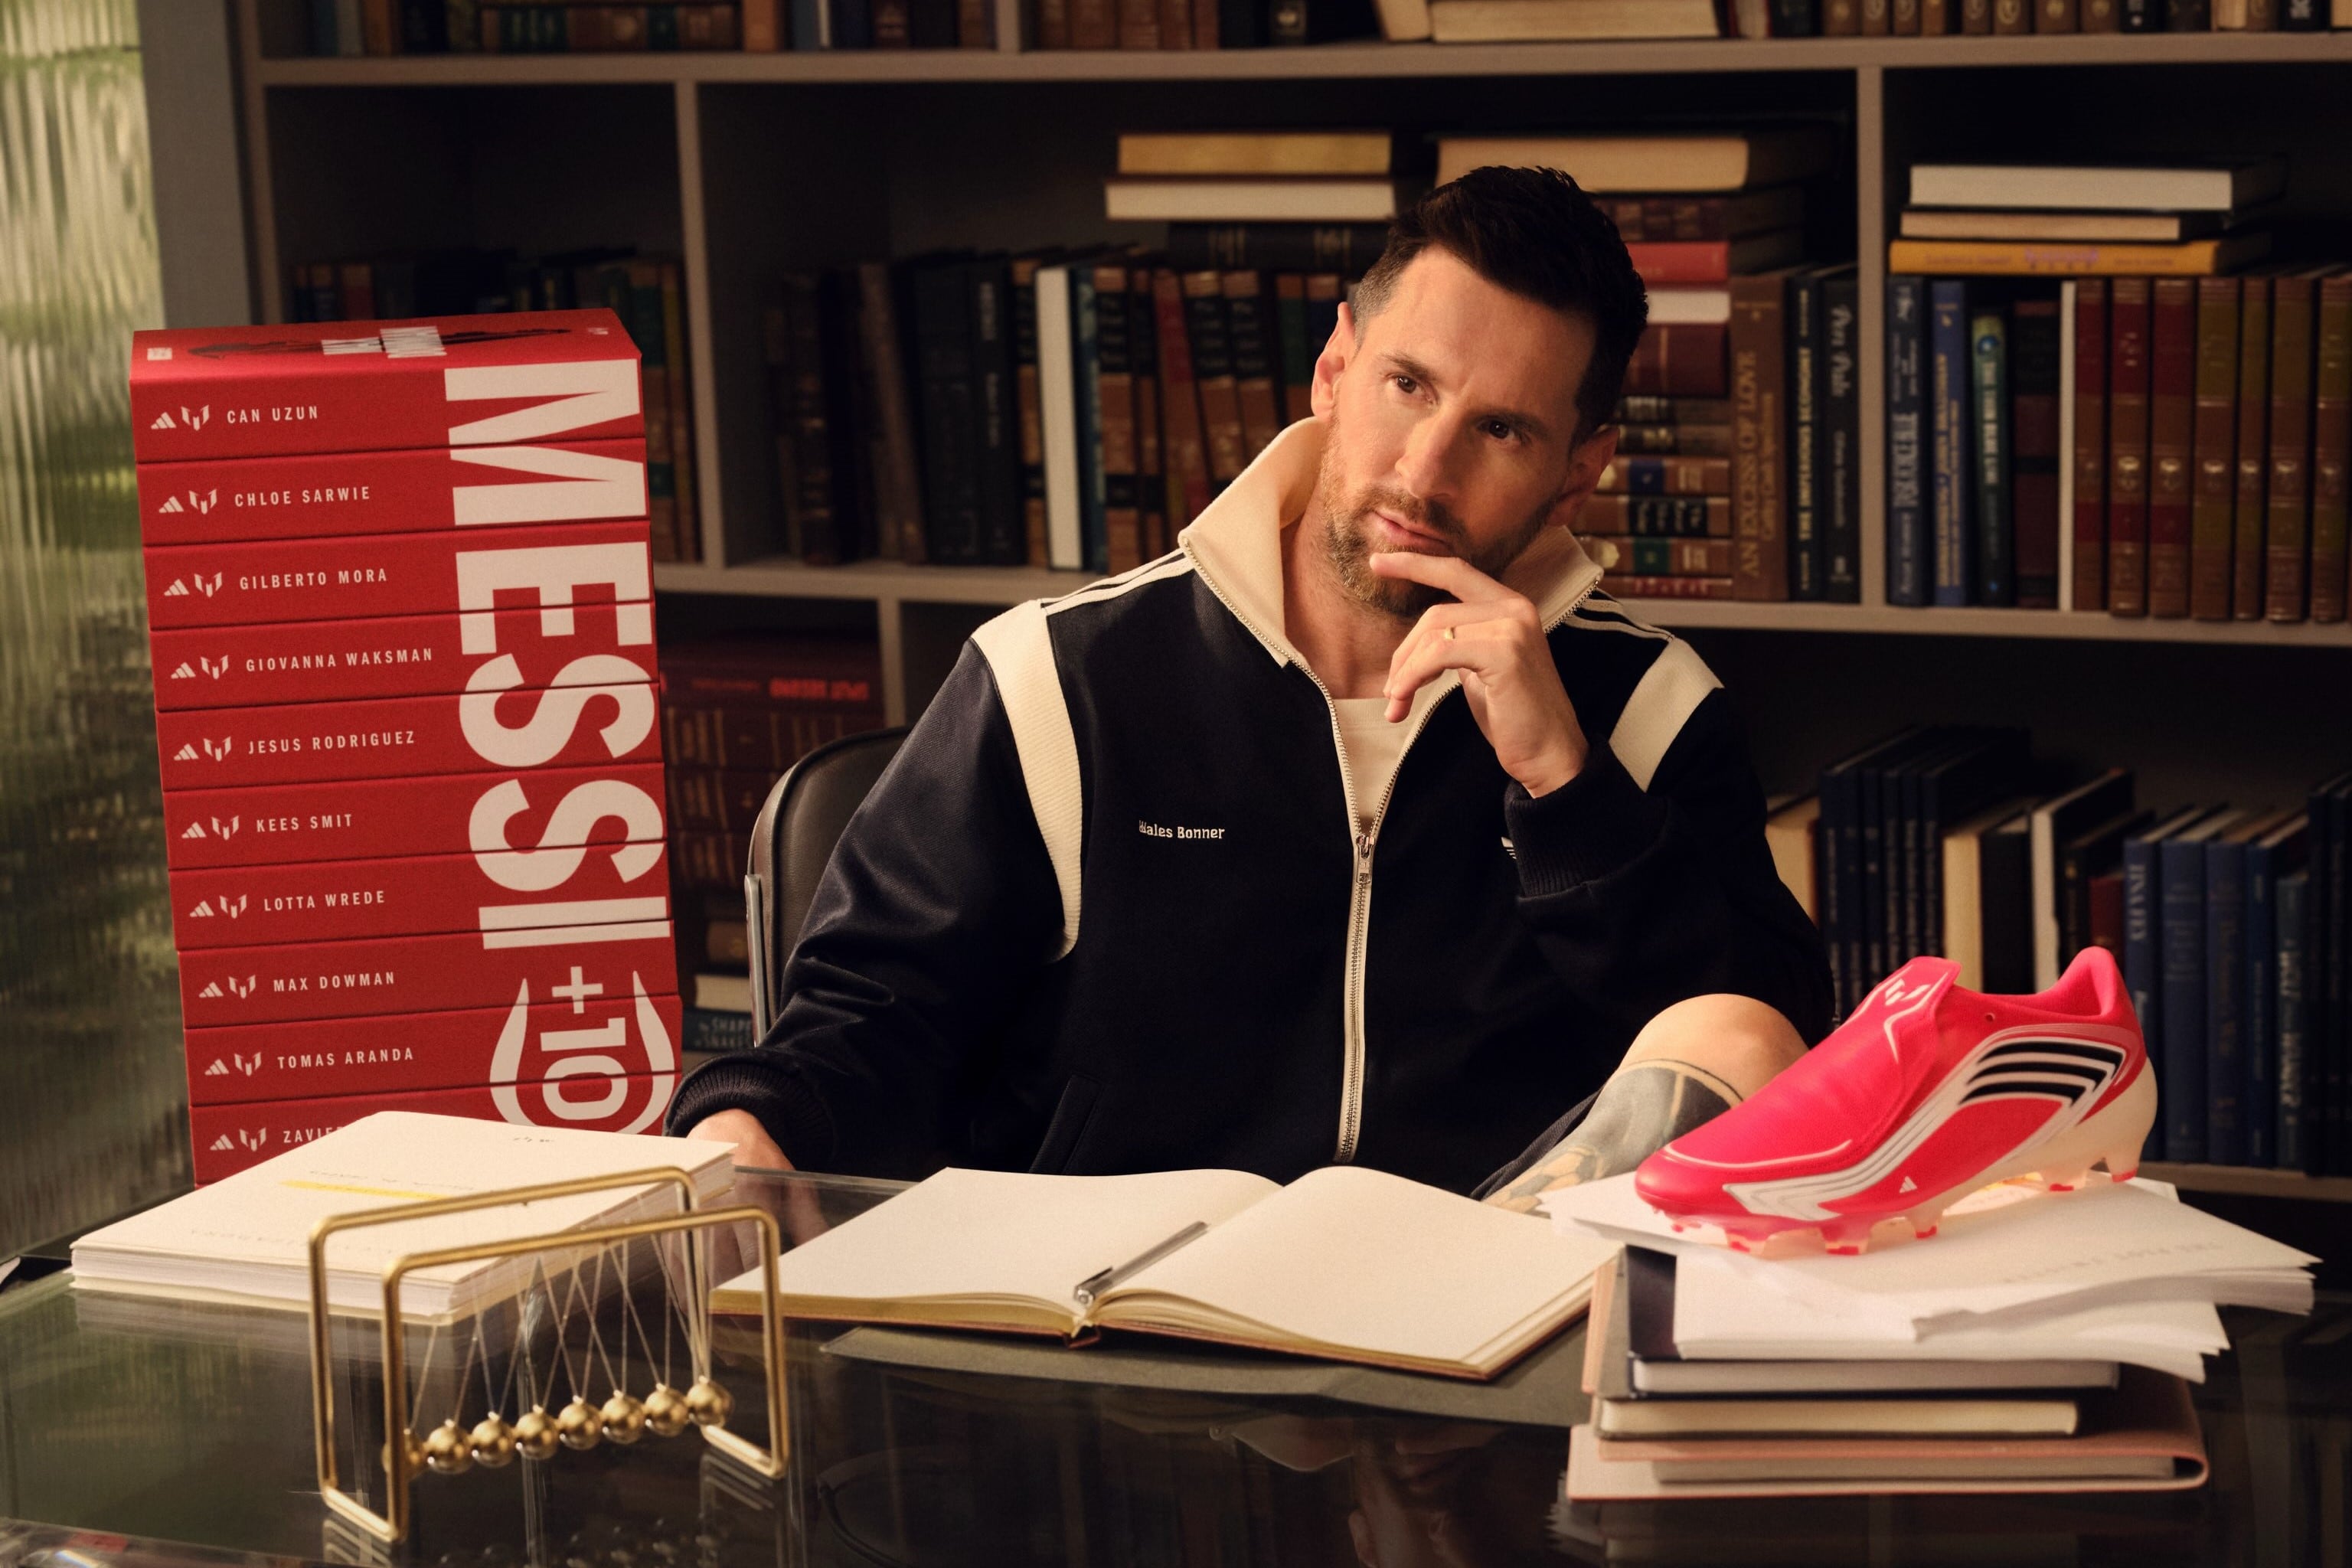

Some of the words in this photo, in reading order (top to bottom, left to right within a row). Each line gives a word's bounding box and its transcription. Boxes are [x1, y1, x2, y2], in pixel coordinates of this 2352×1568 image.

[227, 409, 260, 424] CAN
[272, 406, 318, 421] UZUN
[234, 491, 291, 508] CHLOE
[302, 486, 370, 503] SARWIE
[240, 572, 326, 590] GILBERTO
[338, 568, 387, 584] MORA
[246, 654, 336, 672] GIOVANNA
[345, 648, 432, 666] WAKSMAN
[444, 358, 671, 950] MESSI
[248, 738, 301, 755] JESUS
[312, 730, 414, 750] RODRIGUEZ
[256, 817, 299, 832] KEES
[309, 813, 351, 829] SMIT
[1138, 820, 1174, 838] Wales
[1177, 826, 1225, 839] Bonner
[264, 895, 315, 912] LOTTA
[325, 890, 384, 907] WREDE
[273, 978, 308, 992] MAX
[319, 972, 394, 989] DOWMAN
[277, 1053, 335, 1070] TOMAS
[345, 1047, 413, 1064] ARANDA
[283, 1126, 345, 1144] ZAVIE
